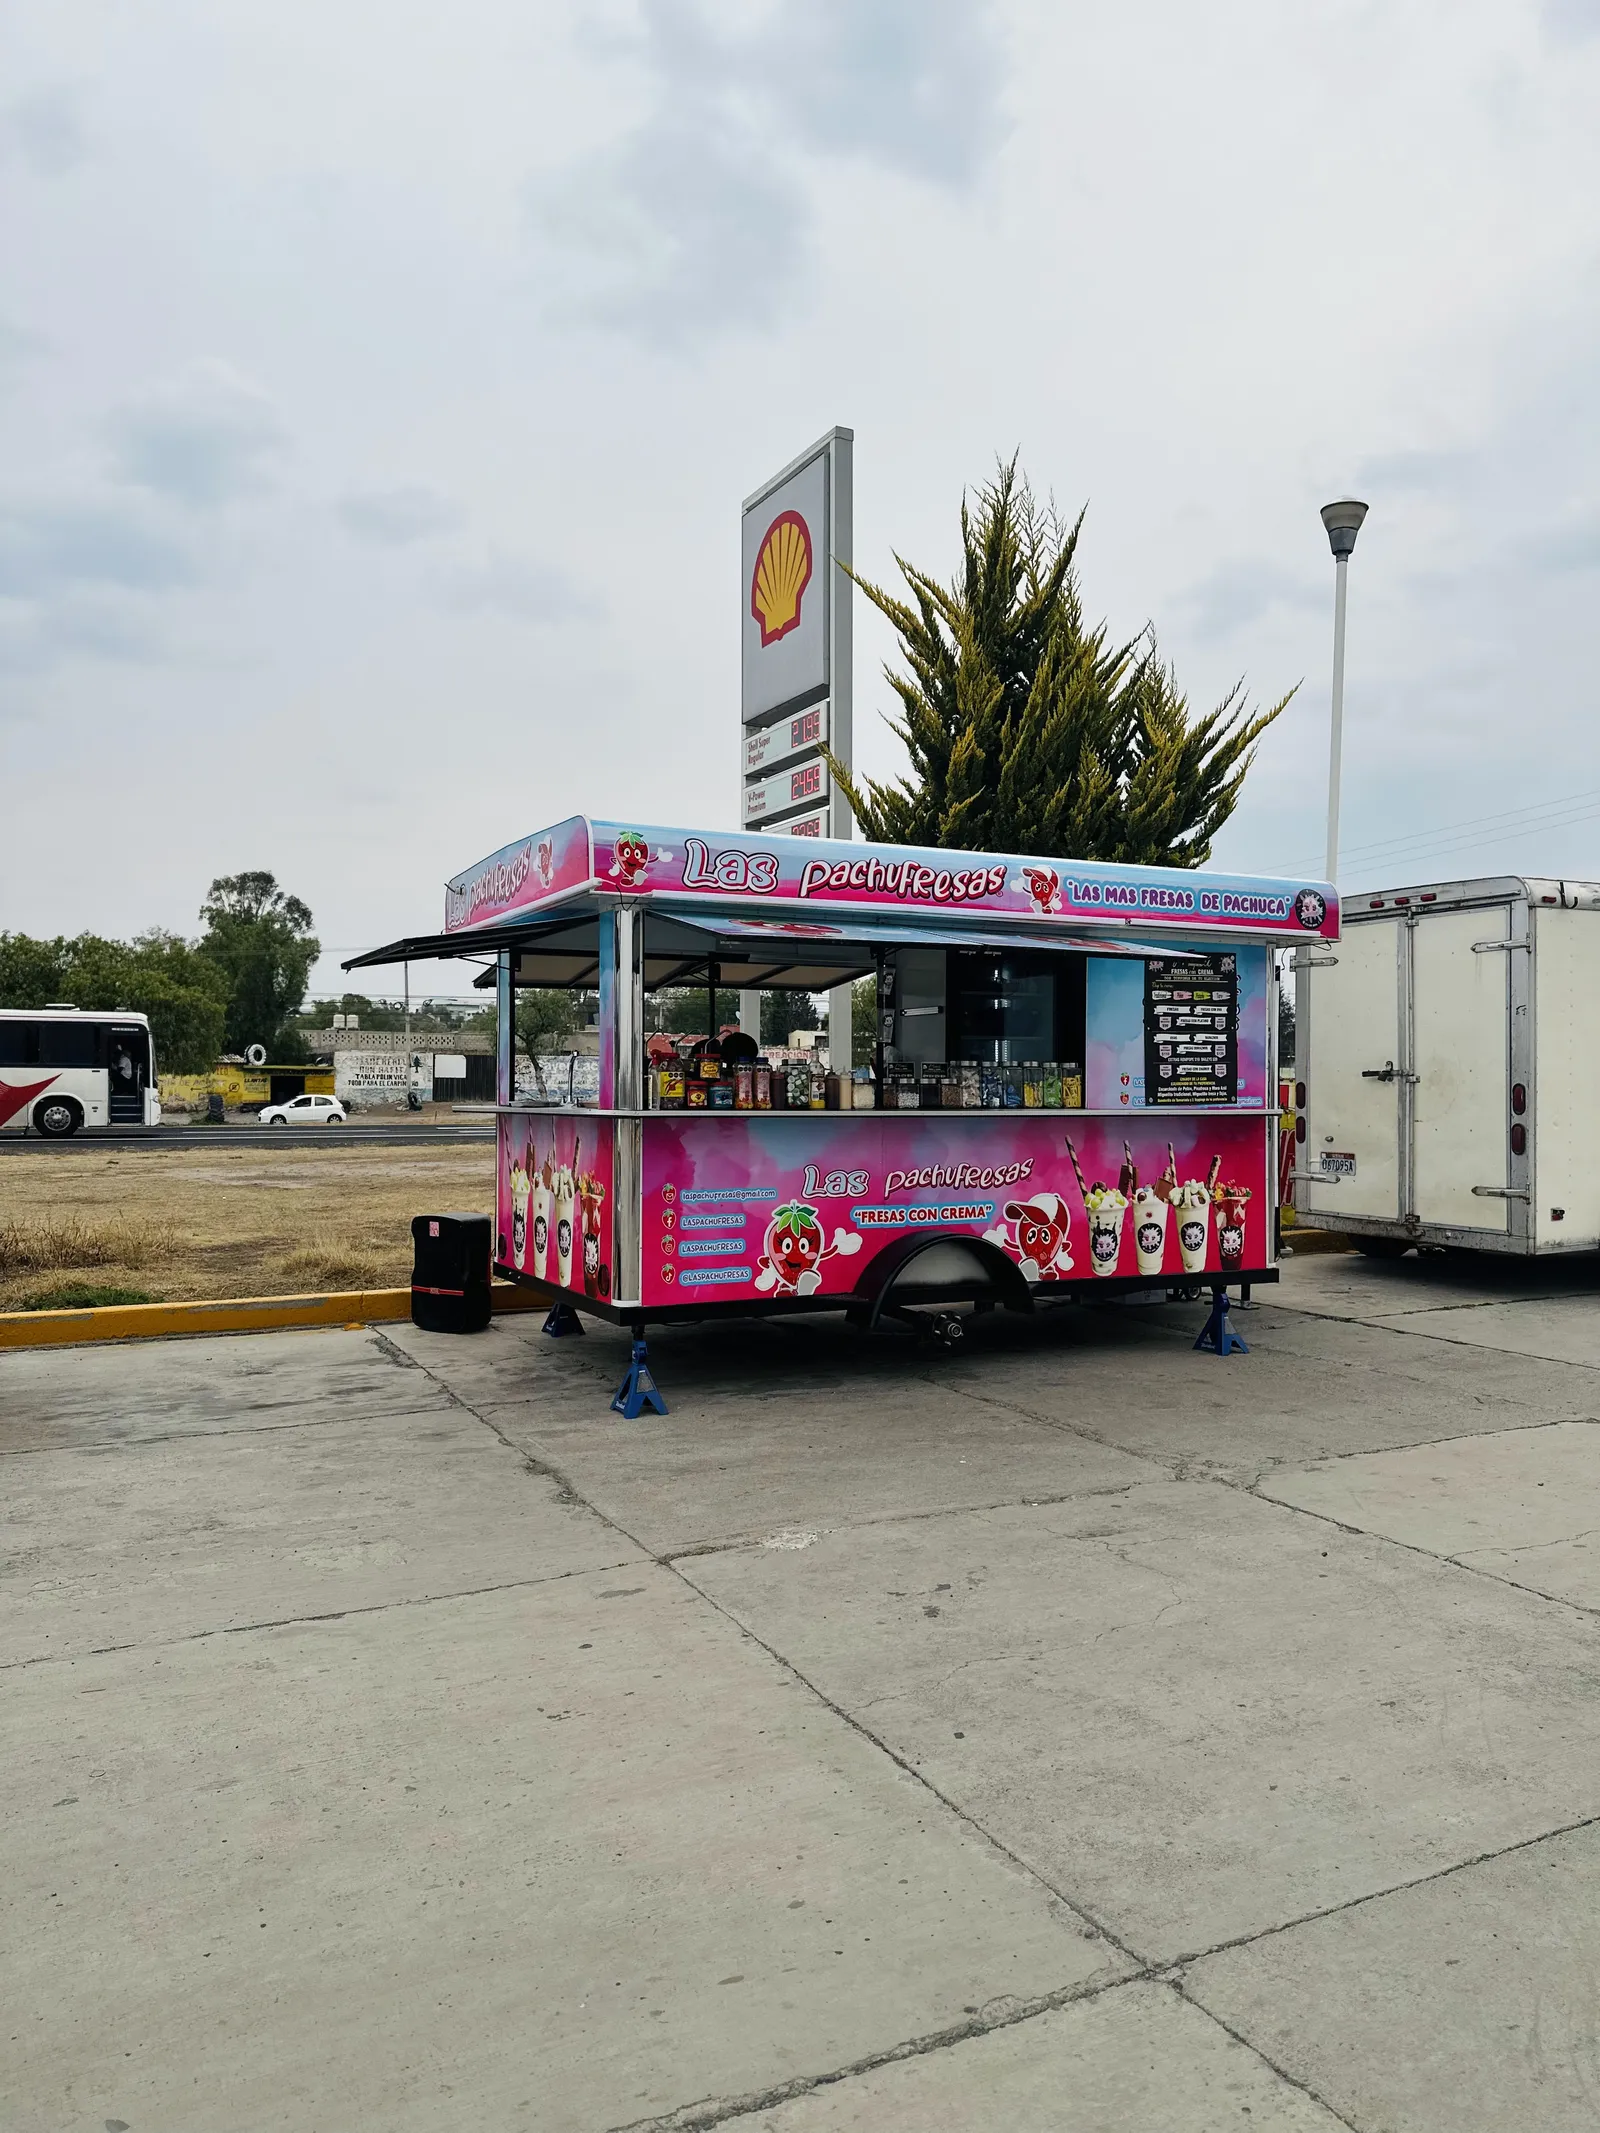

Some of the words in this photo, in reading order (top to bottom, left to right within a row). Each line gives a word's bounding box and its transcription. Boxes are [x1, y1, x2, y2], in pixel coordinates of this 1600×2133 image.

[748, 739, 758, 752] Shell
[759, 737, 770, 748] Super
[748, 750, 764, 765] Regular
[748, 791, 765, 801] V-Power
[748, 802, 766, 814] Premium
[683, 838, 779, 893] Las
[1105, 887, 1137, 904] MAS
[1141, 890, 1193, 909] FRESAS
[1202, 895, 1219, 910] DE
[801, 1165, 870, 1199] Las
[683, 1189, 775, 1201] laspachufresas@gmail.com
[683, 1216, 743, 1227] LASPACHUFRESAS
[854, 1210, 905, 1224] “FRESAS
[909, 1208, 938, 1222] CON
[942, 1206, 992, 1220] CREMA”
[682, 1242, 742, 1253] LASPACHUFRESAS
[682, 1270, 749, 1283] @LASPACHUFRESAS
